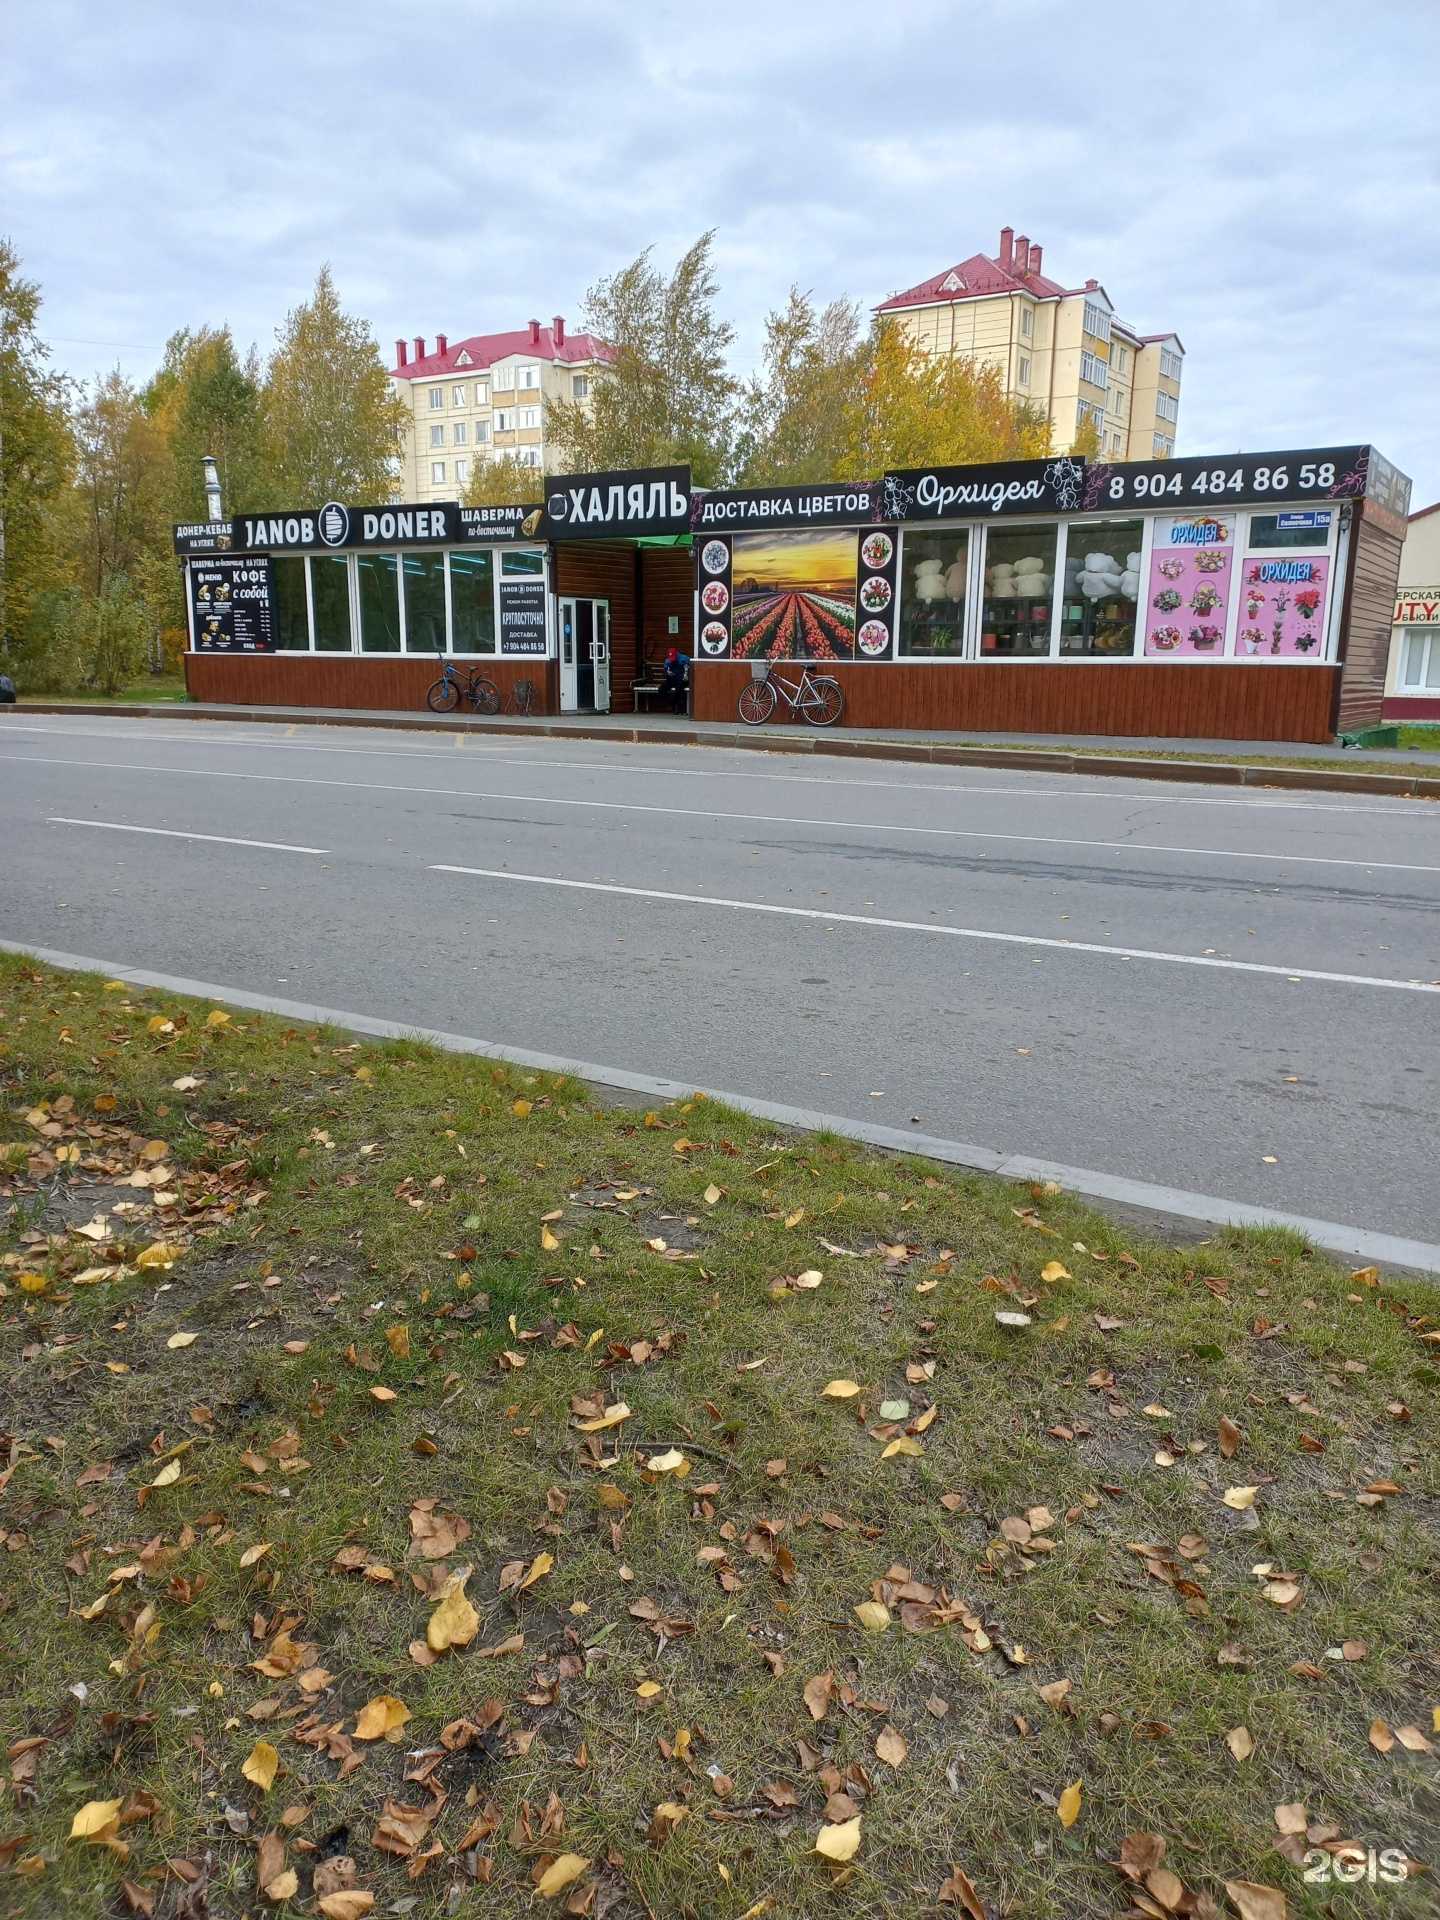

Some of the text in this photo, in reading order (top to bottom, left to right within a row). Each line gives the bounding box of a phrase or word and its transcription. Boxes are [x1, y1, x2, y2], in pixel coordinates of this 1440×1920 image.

[1109, 463, 1336, 499] 8 904 484 86 58
[569, 481, 688, 523] ХАЛЯЛЬ
[916, 474, 1046, 515] Орхидея
[461, 507, 525, 523] ШАВЕРМА
[702, 493, 870, 522] ДОСТАВКА ЦВЕТОВ
[176, 523, 233, 538] ДОНЕР-КЕБАБ
[245, 510, 447, 548] JANOB DONER
[1171, 523, 1219, 546] ОРХИДЕЯ
[232, 570, 267, 583] КОФЕ
[1260, 562, 1313, 584] ОРХИДЕЯ
[502, 611, 544, 625] КРУГЛОСУТОЧНО
